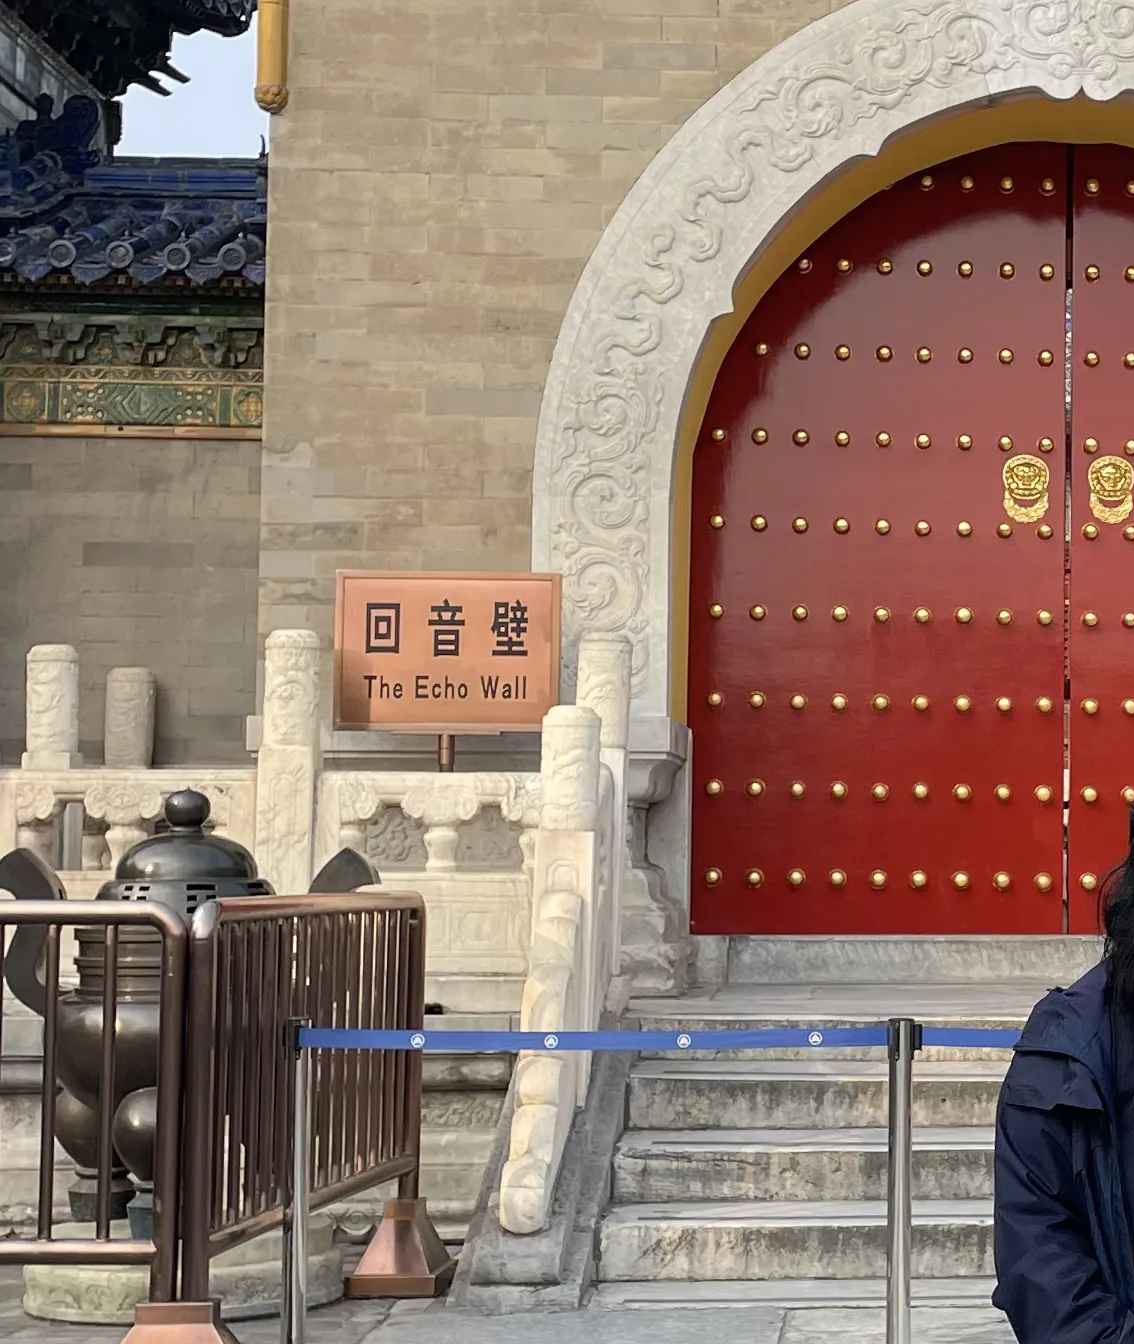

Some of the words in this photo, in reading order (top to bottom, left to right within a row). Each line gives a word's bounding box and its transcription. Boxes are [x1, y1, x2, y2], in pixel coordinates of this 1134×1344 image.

[365, 598, 528, 657] 回音壁
[363, 675, 403, 699] The
[415, 675, 468, 699] Echo
[481, 675, 527, 699] Wall
